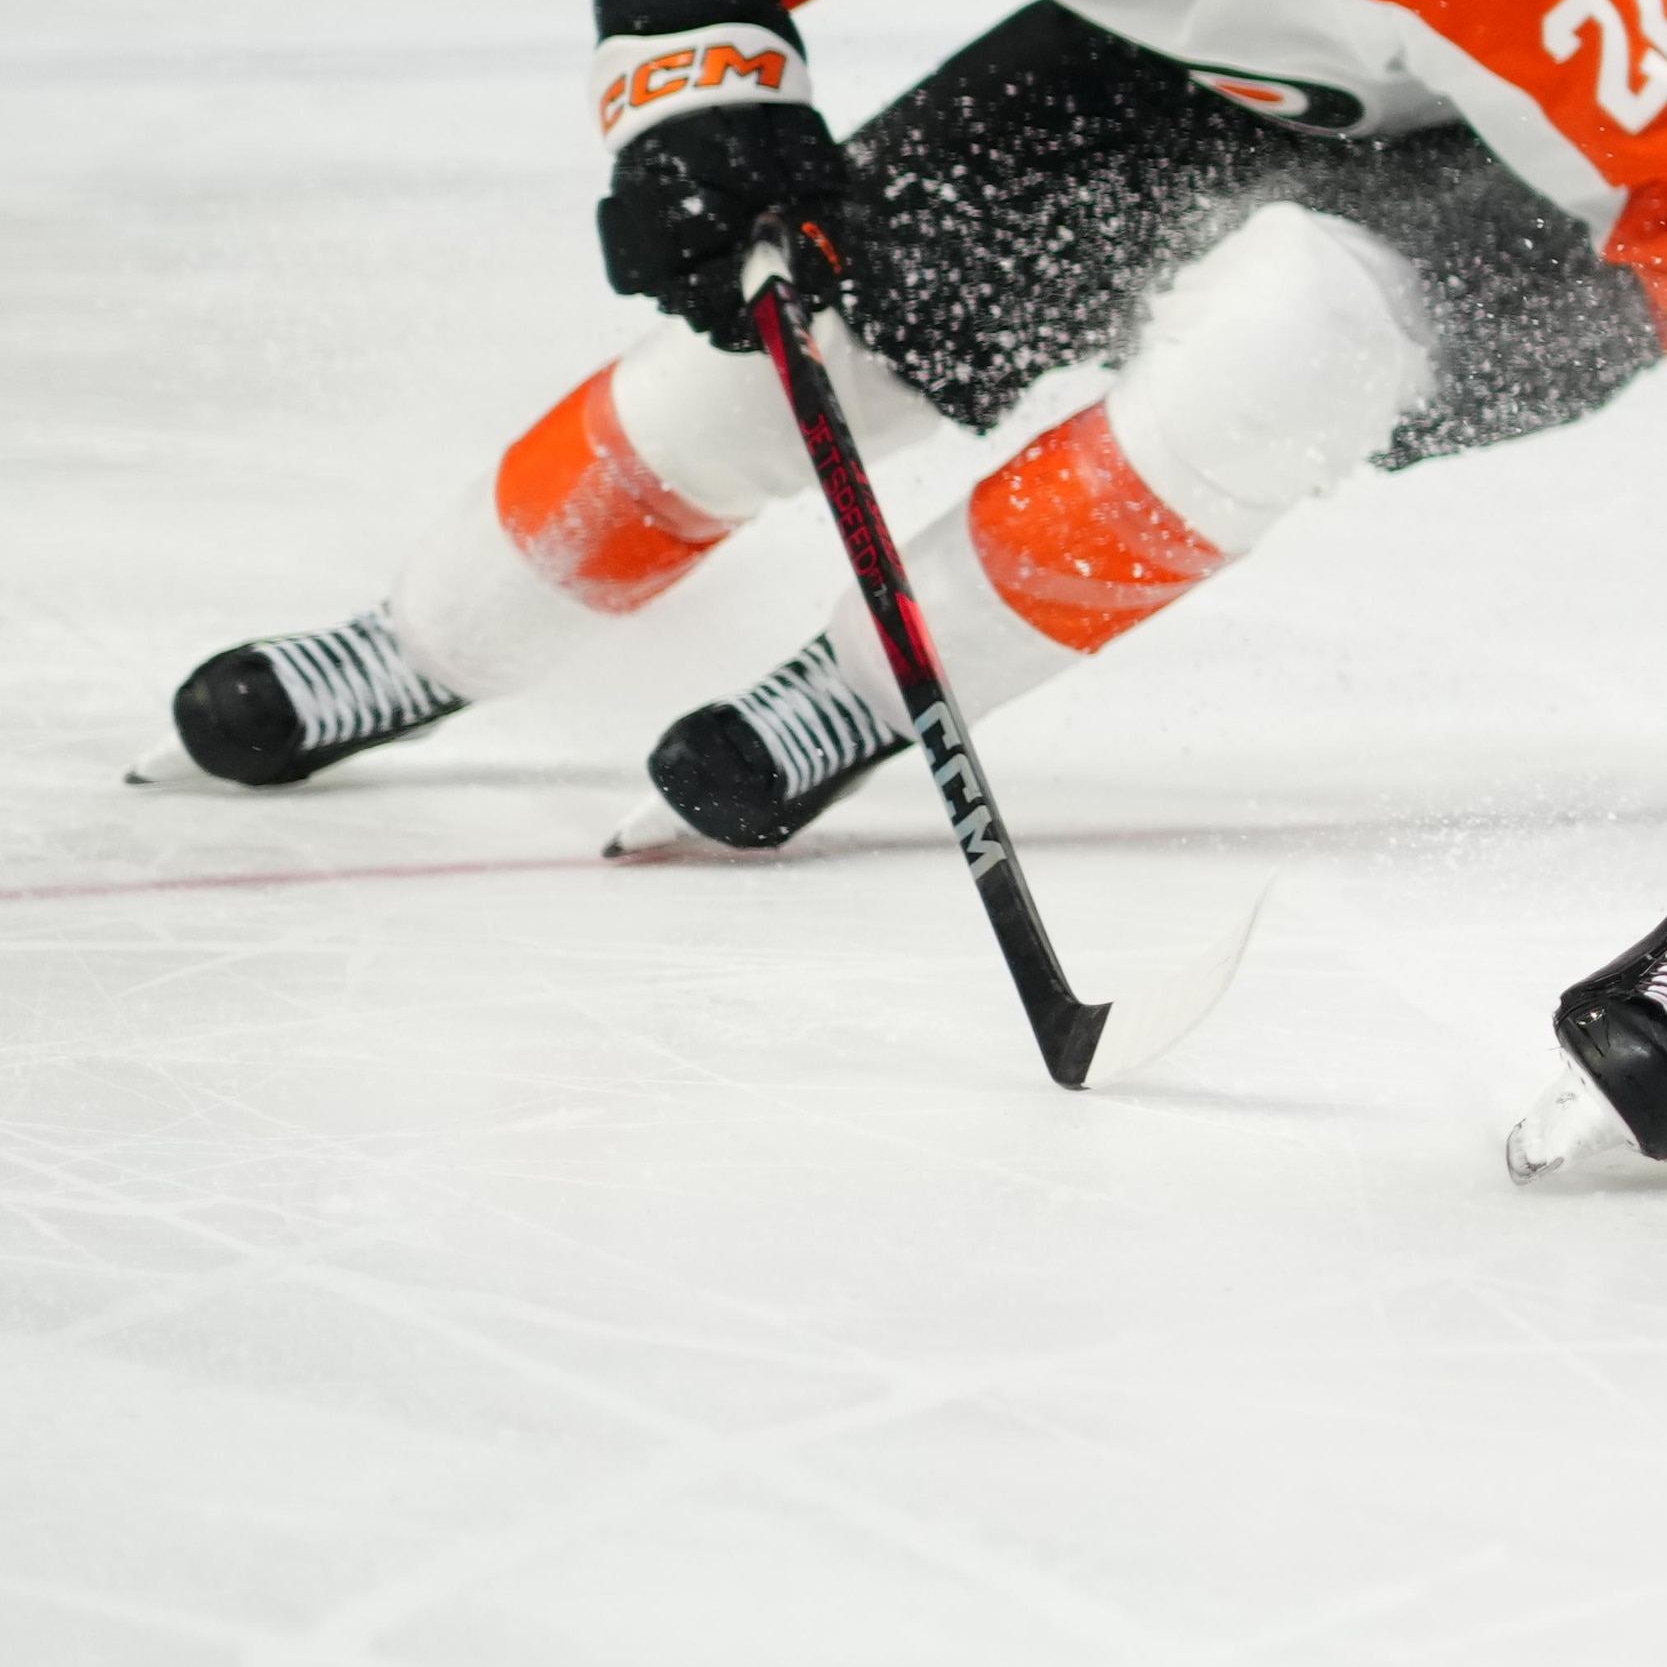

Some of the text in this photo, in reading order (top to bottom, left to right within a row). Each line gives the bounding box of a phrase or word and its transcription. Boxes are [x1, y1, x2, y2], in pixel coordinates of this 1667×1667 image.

[600, 44, 787, 137] CCM
[800, 413, 879, 576] JETSPEED
[913, 700, 1007, 880] CCM
